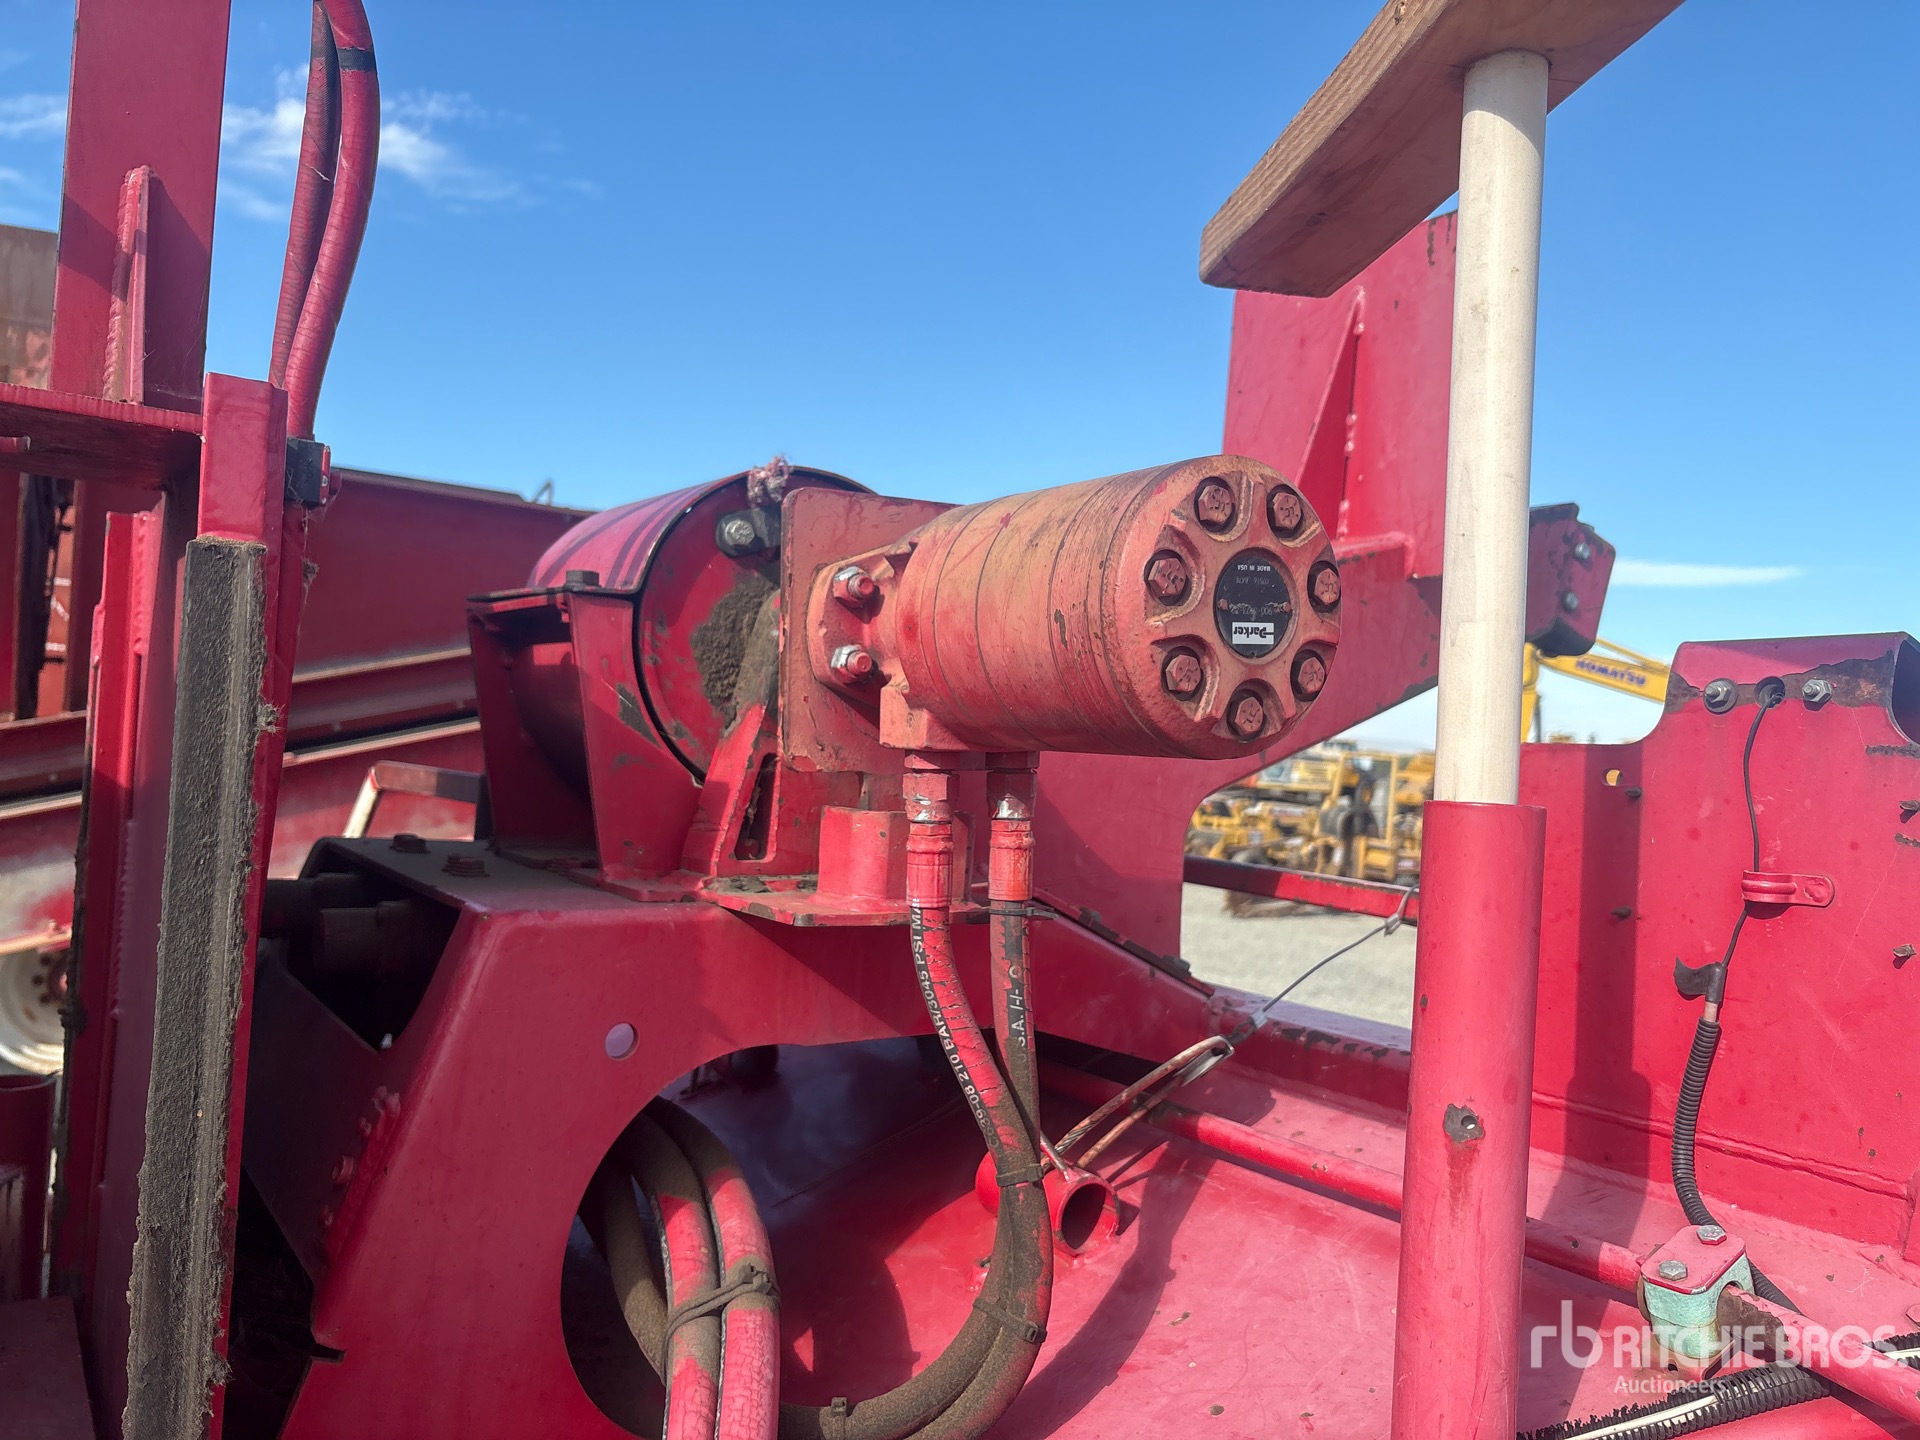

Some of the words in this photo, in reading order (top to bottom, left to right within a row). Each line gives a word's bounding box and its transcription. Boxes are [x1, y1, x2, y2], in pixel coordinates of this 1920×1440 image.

[1233, 626, 1269, 638] Parker
[1576, 660, 1646, 685] KOMATSU
[912, 935, 926, 965] PSI
[949, 1050, 969, 1083] 210
